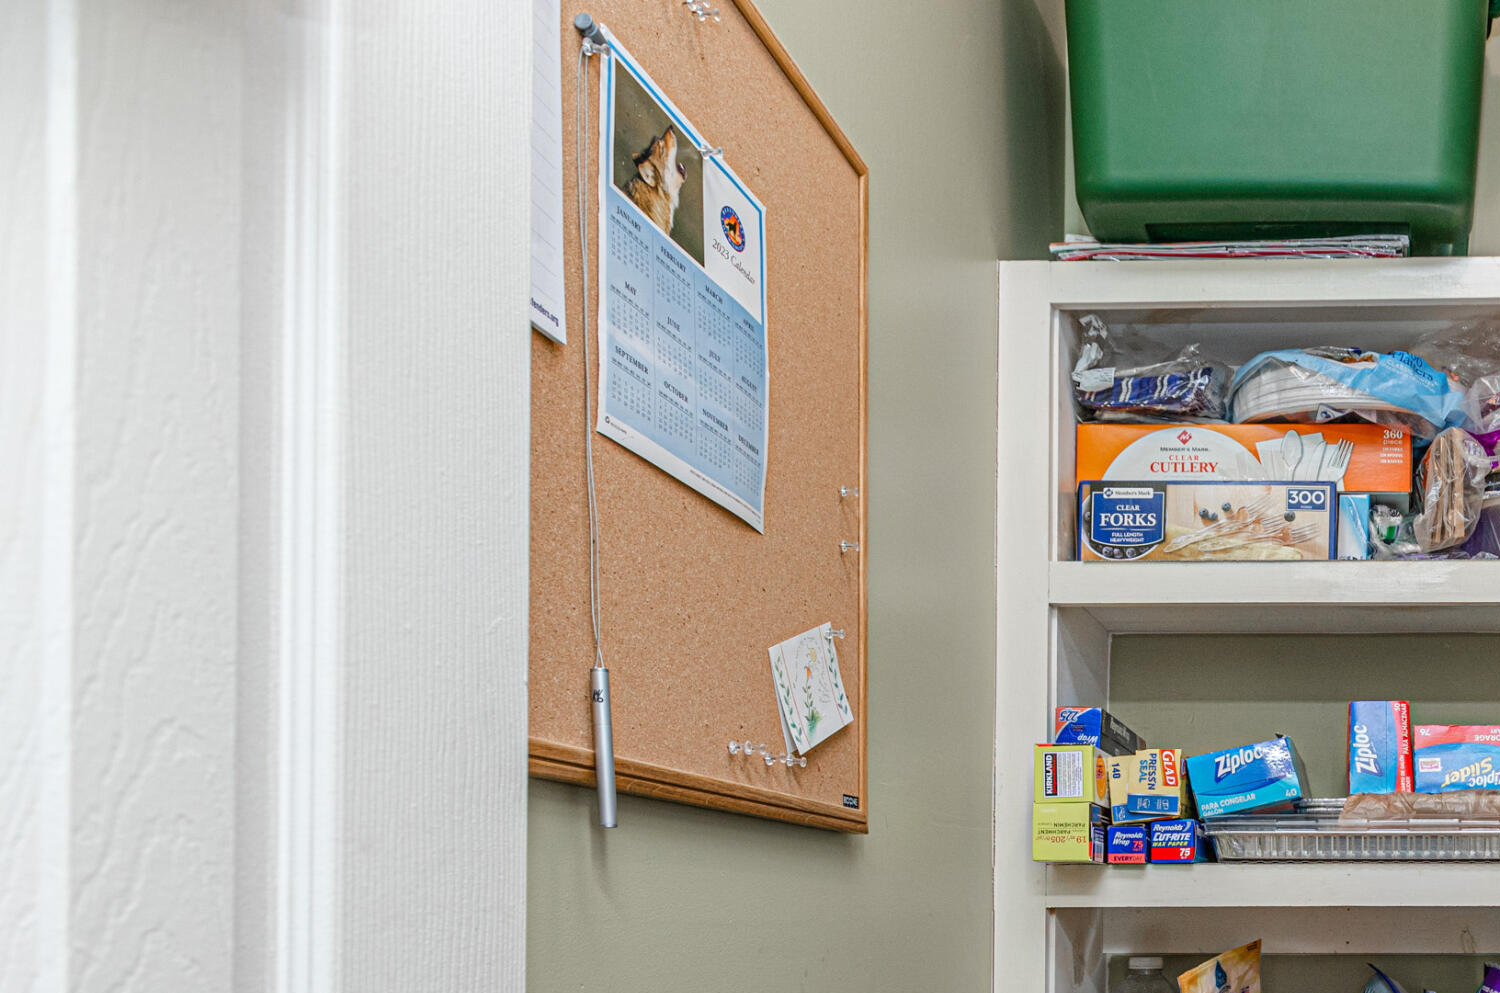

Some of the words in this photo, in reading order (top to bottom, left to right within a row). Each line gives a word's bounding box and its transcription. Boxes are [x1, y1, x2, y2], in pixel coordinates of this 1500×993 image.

[616, 206, 642, 233] JANUARY
[660, 246, 687, 273] FEBRUARY
[712, 238, 730, 261] 2023
[730, 254, 756, 285] Calendar
[615, 345, 650, 375] SEPTEMBER
[663, 380, 689, 404] OCTOBER
[1383, 429, 1403, 440] 360
[1150, 462, 1219, 473] CUTLERY
[1287, 490, 1325, 504] 300
[1099, 513, 1157, 527] FORKS
[1060, 710, 1079, 722] 225
[1077, 733, 1099, 743] Wrap
[1419, 728, 1431, 736] 76
[1353, 724, 1379, 774] Ziploc
[1161, 751, 1177, 786] GLAD
[1214, 745, 1264, 778] Ziploc
[1045, 754, 1053, 795] KIRKLAND
[1111, 763, 1121, 779] 140
[1139, 759, 1148, 783] SEAL
[1147, 752, 1158, 791] PRESS'N
[1441, 757, 1493, 788] Slider
[1285, 787, 1297, 797] 40
[1201, 800, 1219, 811] PARA
[1219, 793, 1256, 807] CONGELAR
[1114, 831, 1144, 839] Reynolds
[1152, 823, 1184, 832] Reynolds
[1112, 838, 1131, 846] Wrap
[1152, 832, 1192, 841] CUT-RITE
[1133, 840, 1144, 849] 75
[1179, 848, 1191, 857] 75
